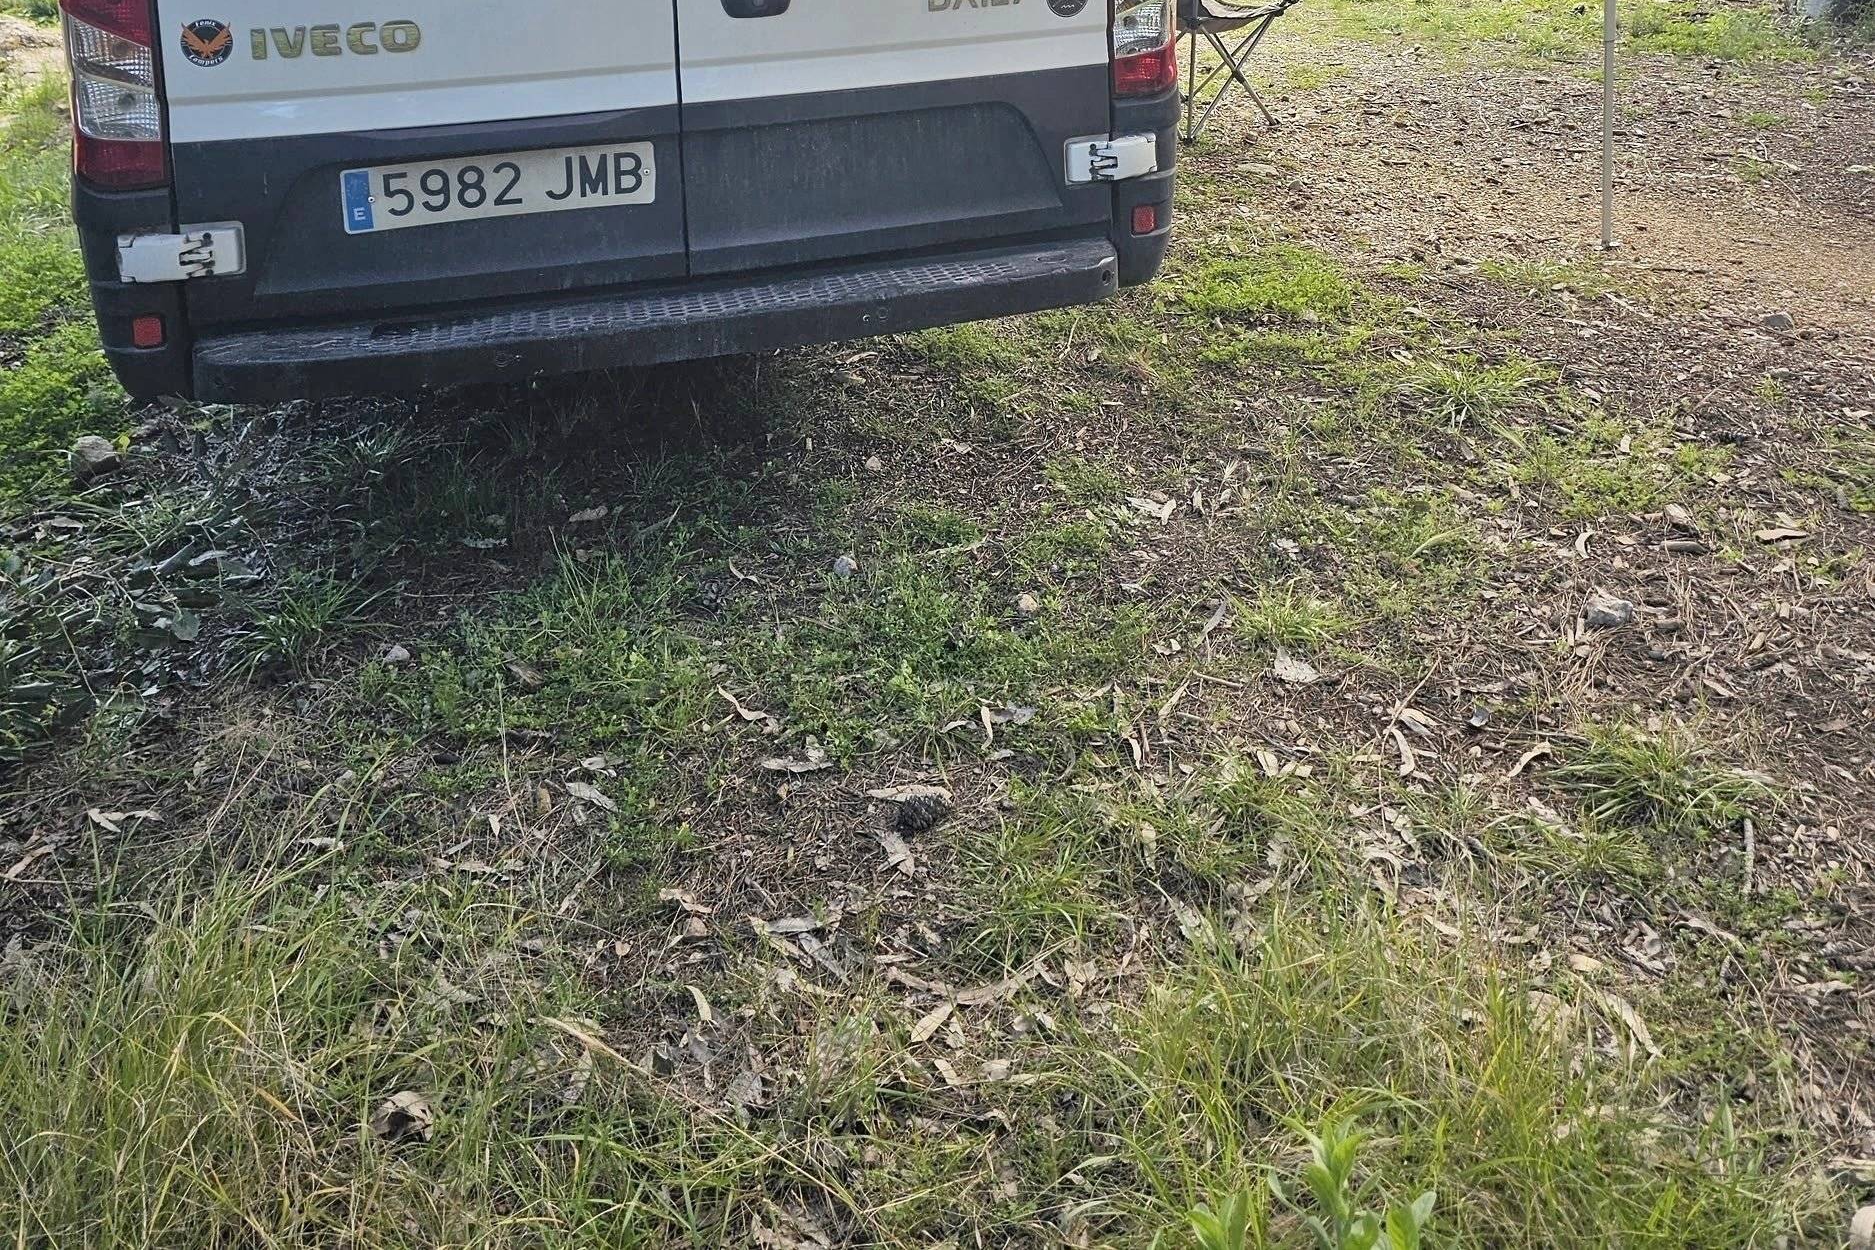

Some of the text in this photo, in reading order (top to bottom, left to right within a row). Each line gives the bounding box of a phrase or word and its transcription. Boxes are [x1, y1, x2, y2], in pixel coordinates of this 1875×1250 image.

[250, 19, 422, 61] IVECO
[353, 151, 643, 222] E 5982 JMB
